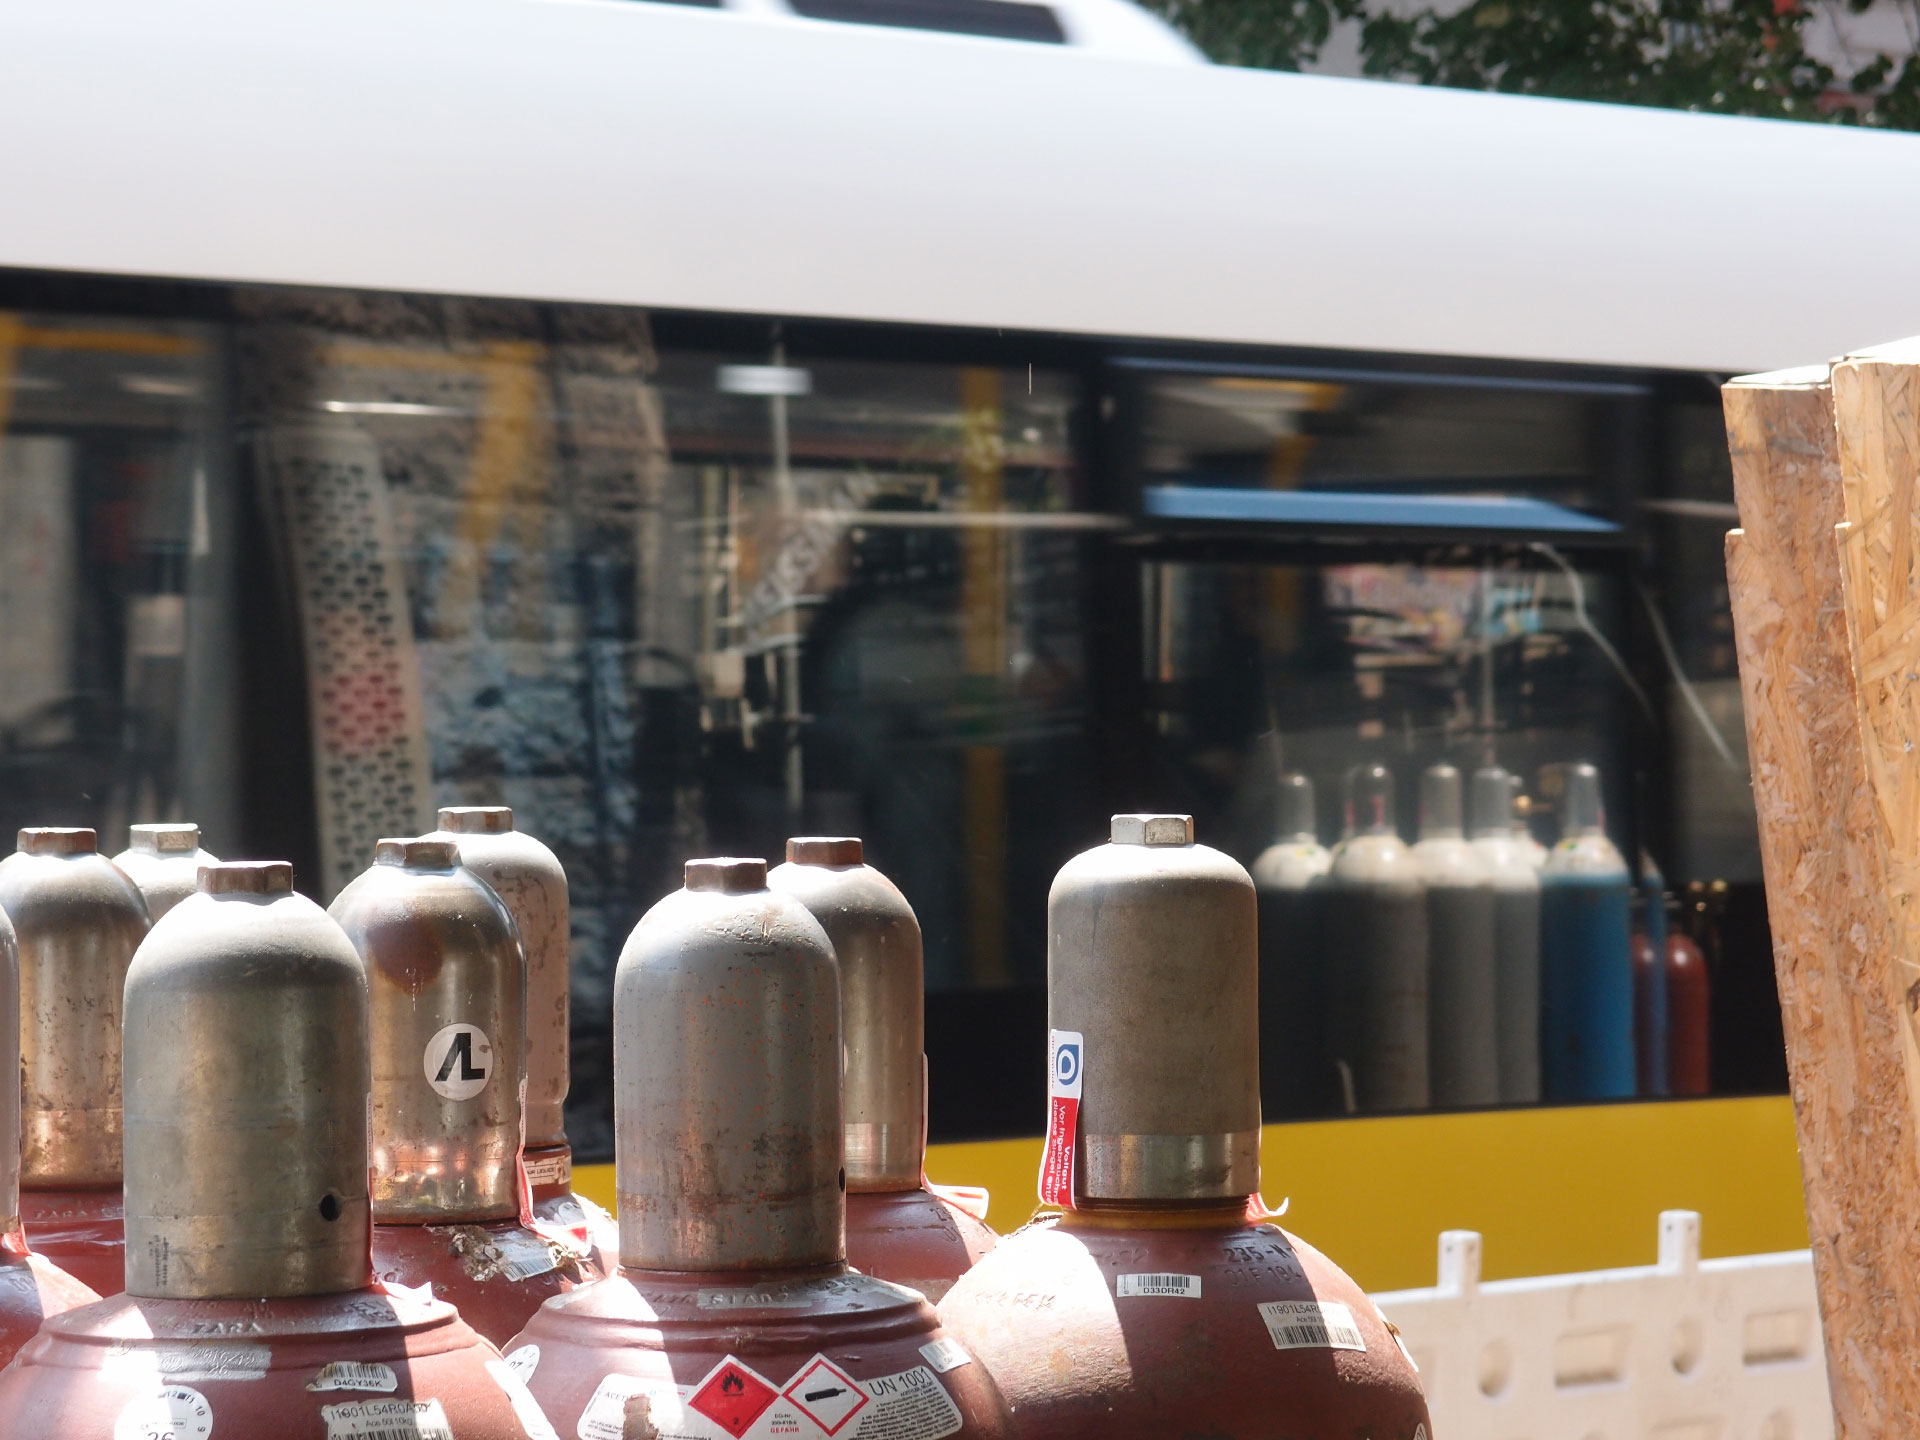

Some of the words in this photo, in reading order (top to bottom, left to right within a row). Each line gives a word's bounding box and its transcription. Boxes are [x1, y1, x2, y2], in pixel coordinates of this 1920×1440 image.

[1061, 1145, 1071, 1190] Vollgut
[1143, 1287, 1186, 1295] D33DR42
[869, 1378, 898, 1396] UN
[898, 1366, 932, 1389] 1001
[770, 1426, 800, 1434] GEFAHR
